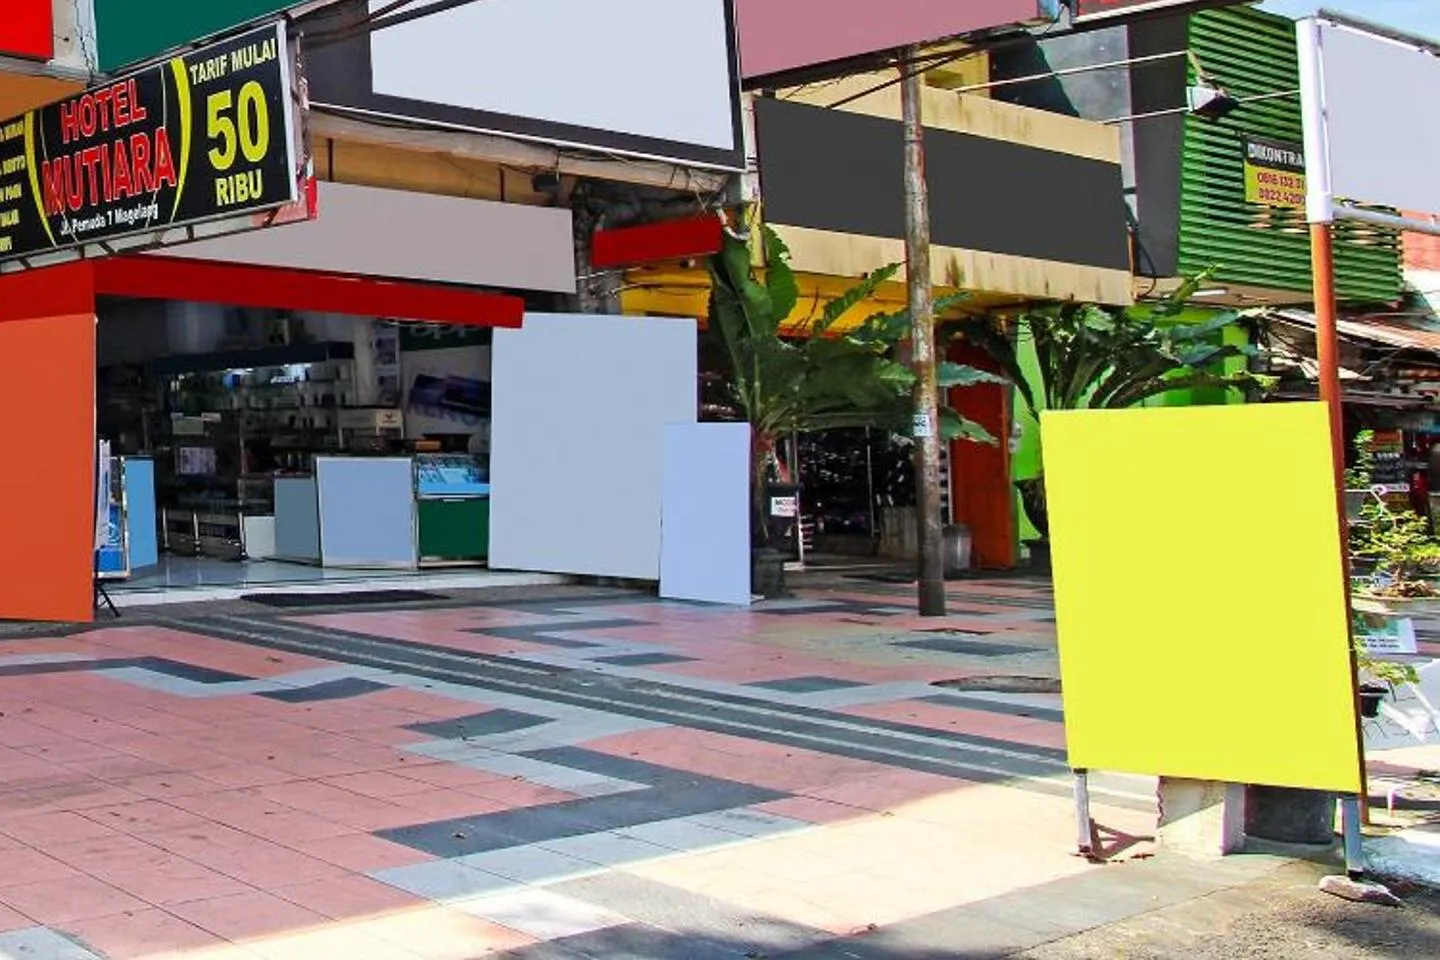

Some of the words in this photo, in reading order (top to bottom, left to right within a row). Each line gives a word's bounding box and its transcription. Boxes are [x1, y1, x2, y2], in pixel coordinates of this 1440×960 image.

[190, 54, 228, 86] TARIF
[230, 37, 277, 72] MULAI
[60, 78, 147, 145] HOTEL
[206, 80, 270, 171] 50
[41, 127, 177, 218] MUTIARA
[215, 169, 263, 207] RIBU
[72, 213, 107, 233] Pemuda
